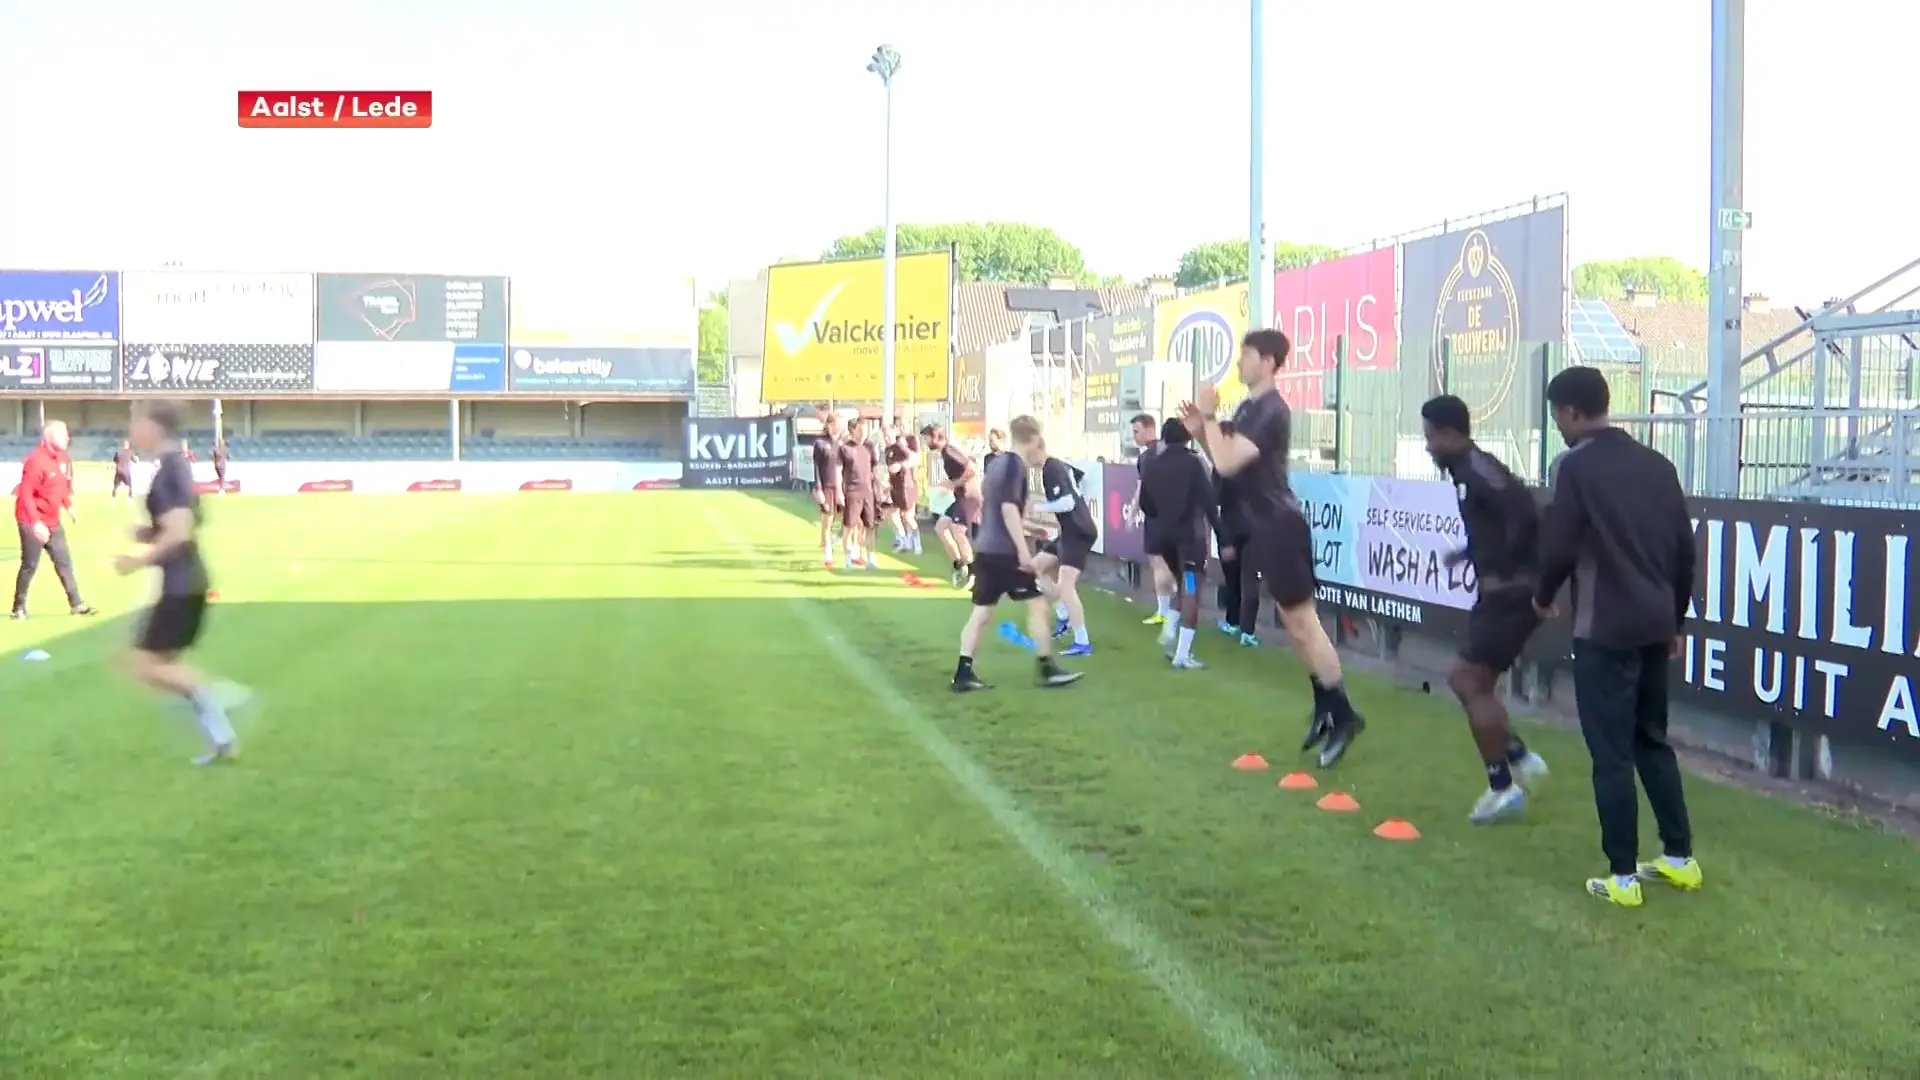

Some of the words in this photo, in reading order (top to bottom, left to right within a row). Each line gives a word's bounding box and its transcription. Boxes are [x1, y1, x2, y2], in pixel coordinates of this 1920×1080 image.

[813, 314, 941, 344] Valckenier
[1468, 305, 1482, 328] DE
[1445, 327, 1507, 355] ROUWERIJ
[689, 423, 768, 460] kvik
[1301, 500, 1342, 532] ALON
[1366, 508, 1389, 529] SELF
[1392, 510, 1432, 534] SERVICE
[1435, 515, 1460, 538] DOG
[1368, 541, 1420, 585] WASH
[1425, 550, 1439, 592] A
[1684, 518, 1920, 658] IMILI
[1344, 590, 1368, 611] VAN
[1371, 598, 1422, 624] LAETHEM
[1752, 647, 1848, 718] UIT
